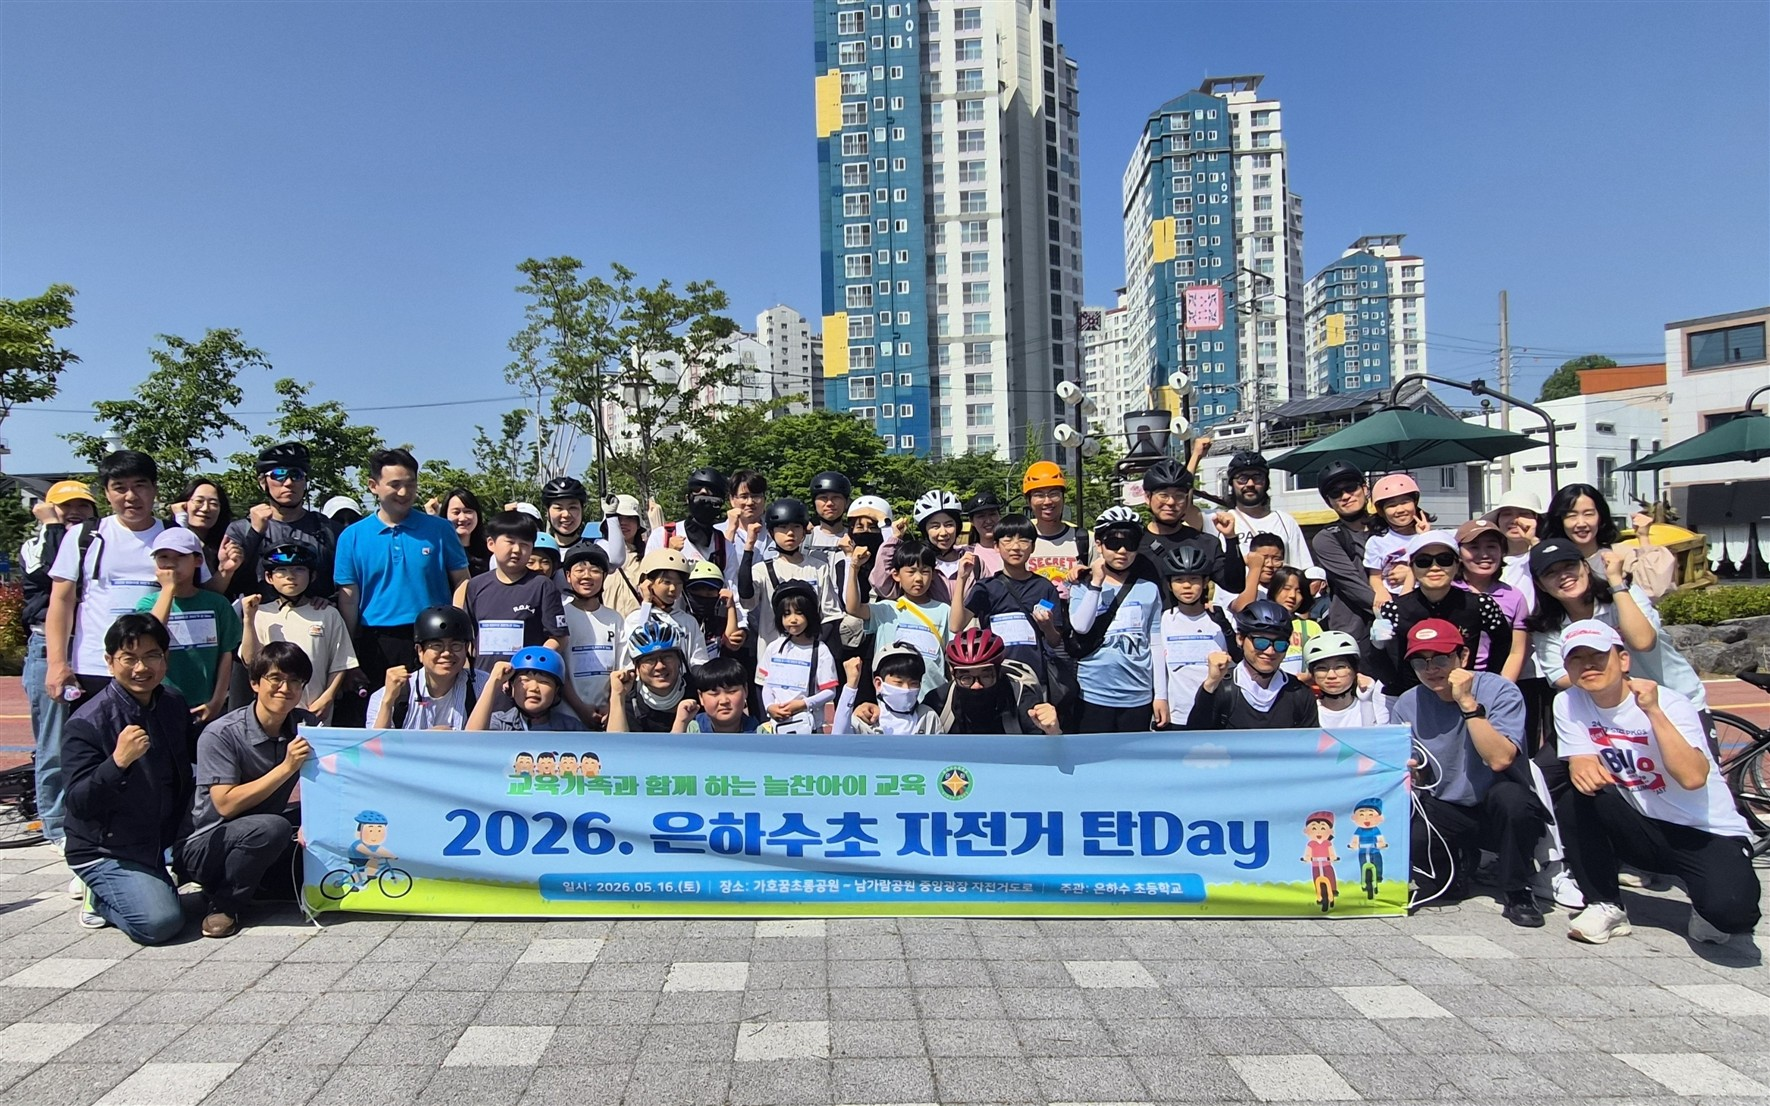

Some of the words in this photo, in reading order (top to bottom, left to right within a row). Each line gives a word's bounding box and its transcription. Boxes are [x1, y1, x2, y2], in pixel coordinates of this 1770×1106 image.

[905, 2, 914, 49] 101
[1221, 171, 1229, 204] 102
[1029, 557, 1076, 571] SECRET
[607, 631, 615, 642] P
[507, 774, 640, 796] 교육가족과
[645, 775, 697, 796] 함께
[705, 775, 757, 796] 하는
[763, 775, 867, 796] 늘찬아이
[874, 774, 926, 796] 교육
[443, 809, 634, 856] 2026.
[650, 810, 881, 857] 은하수초
[896, 811, 1063, 857] 자전거
[1080, 811, 1270, 870] 탄Day
[562, 881, 592, 893] 일시:
[596, 881, 700, 893] 2026.05.16.(토)
[719, 880, 749, 893] 장소:
[753, 880, 840, 893] 가호꿈초롱공원
[854, 879, 915, 893] 남가람공원
[919, 880, 968, 893] 중앙광장
[972, 882, 1033, 893] 자전거도로
[1060, 882, 1089, 894] 주관:
[1093, 882, 1130, 895] 은하수
[1133, 882, 1183, 895] 초등학교
